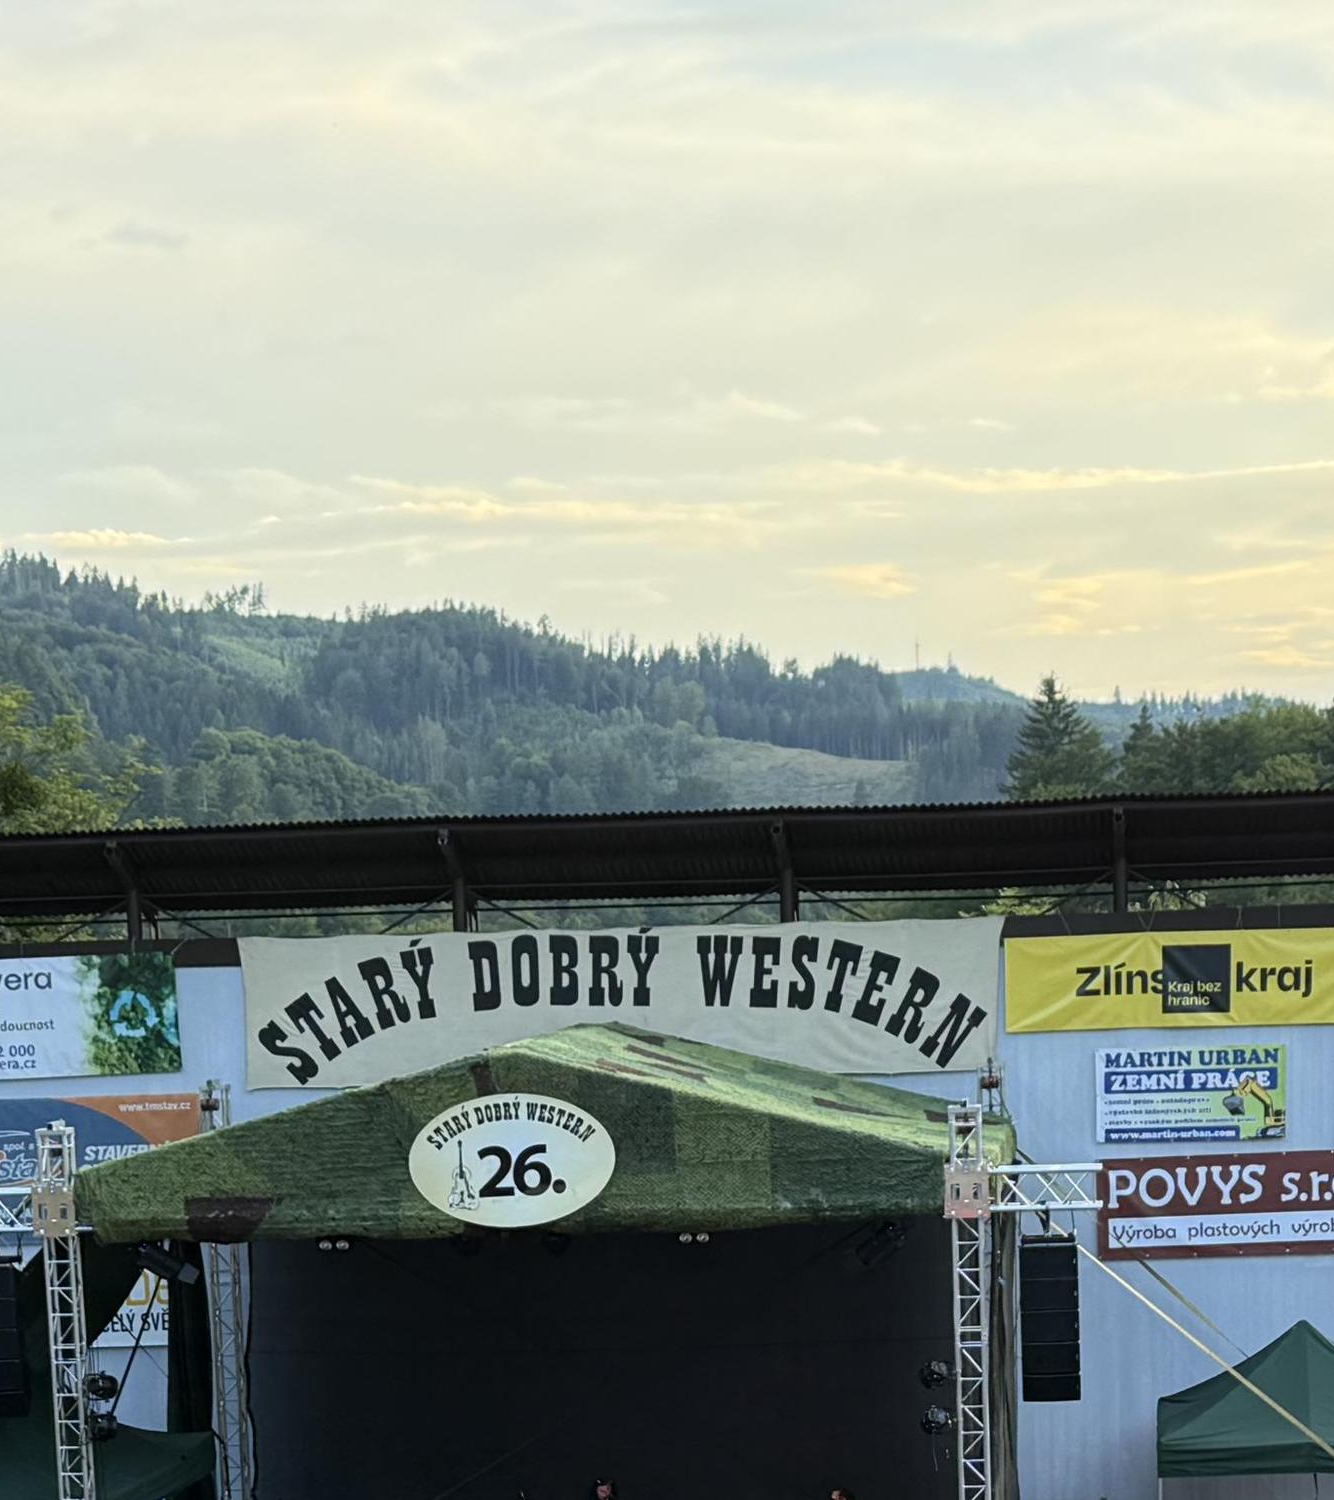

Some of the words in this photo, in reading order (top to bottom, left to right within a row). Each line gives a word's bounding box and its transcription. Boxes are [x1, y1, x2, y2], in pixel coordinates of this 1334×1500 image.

[1167, 980, 1194, 994] Kraj
[1197, 979, 1223, 993] bez
[1236, 959, 1313, 998] kraj
[257, 938, 436, 1086] STARÝ
[467, 926, 660, 1012] DOBRÝ
[696, 932, 987, 1070] WESTERN
[1167, 994, 1210, 1006] hranic
[8, 1044, 36, 1057] 000
[1105, 1049, 1192, 1069] MARTIN
[1198, 1047, 1280, 1067] URBAN
[1110, 1068, 1186, 1091] ZEMNÍ
[1191, 1067, 1271, 1090] PRÁCE
[426, 1104, 473, 1151] STARÝ
[473, 1096, 521, 1126] DOBRÝ
[526, 1101, 596, 1143] WESTERN
[1109, 1127, 1237, 1141] www.martin-urban.com
[477, 1143, 567, 1198] 26.
[1107, 1163, 1267, 1209] POVYS
[1112, 1217, 1178, 1242] Výroba
[1188, 1217, 1282, 1242] plastových
